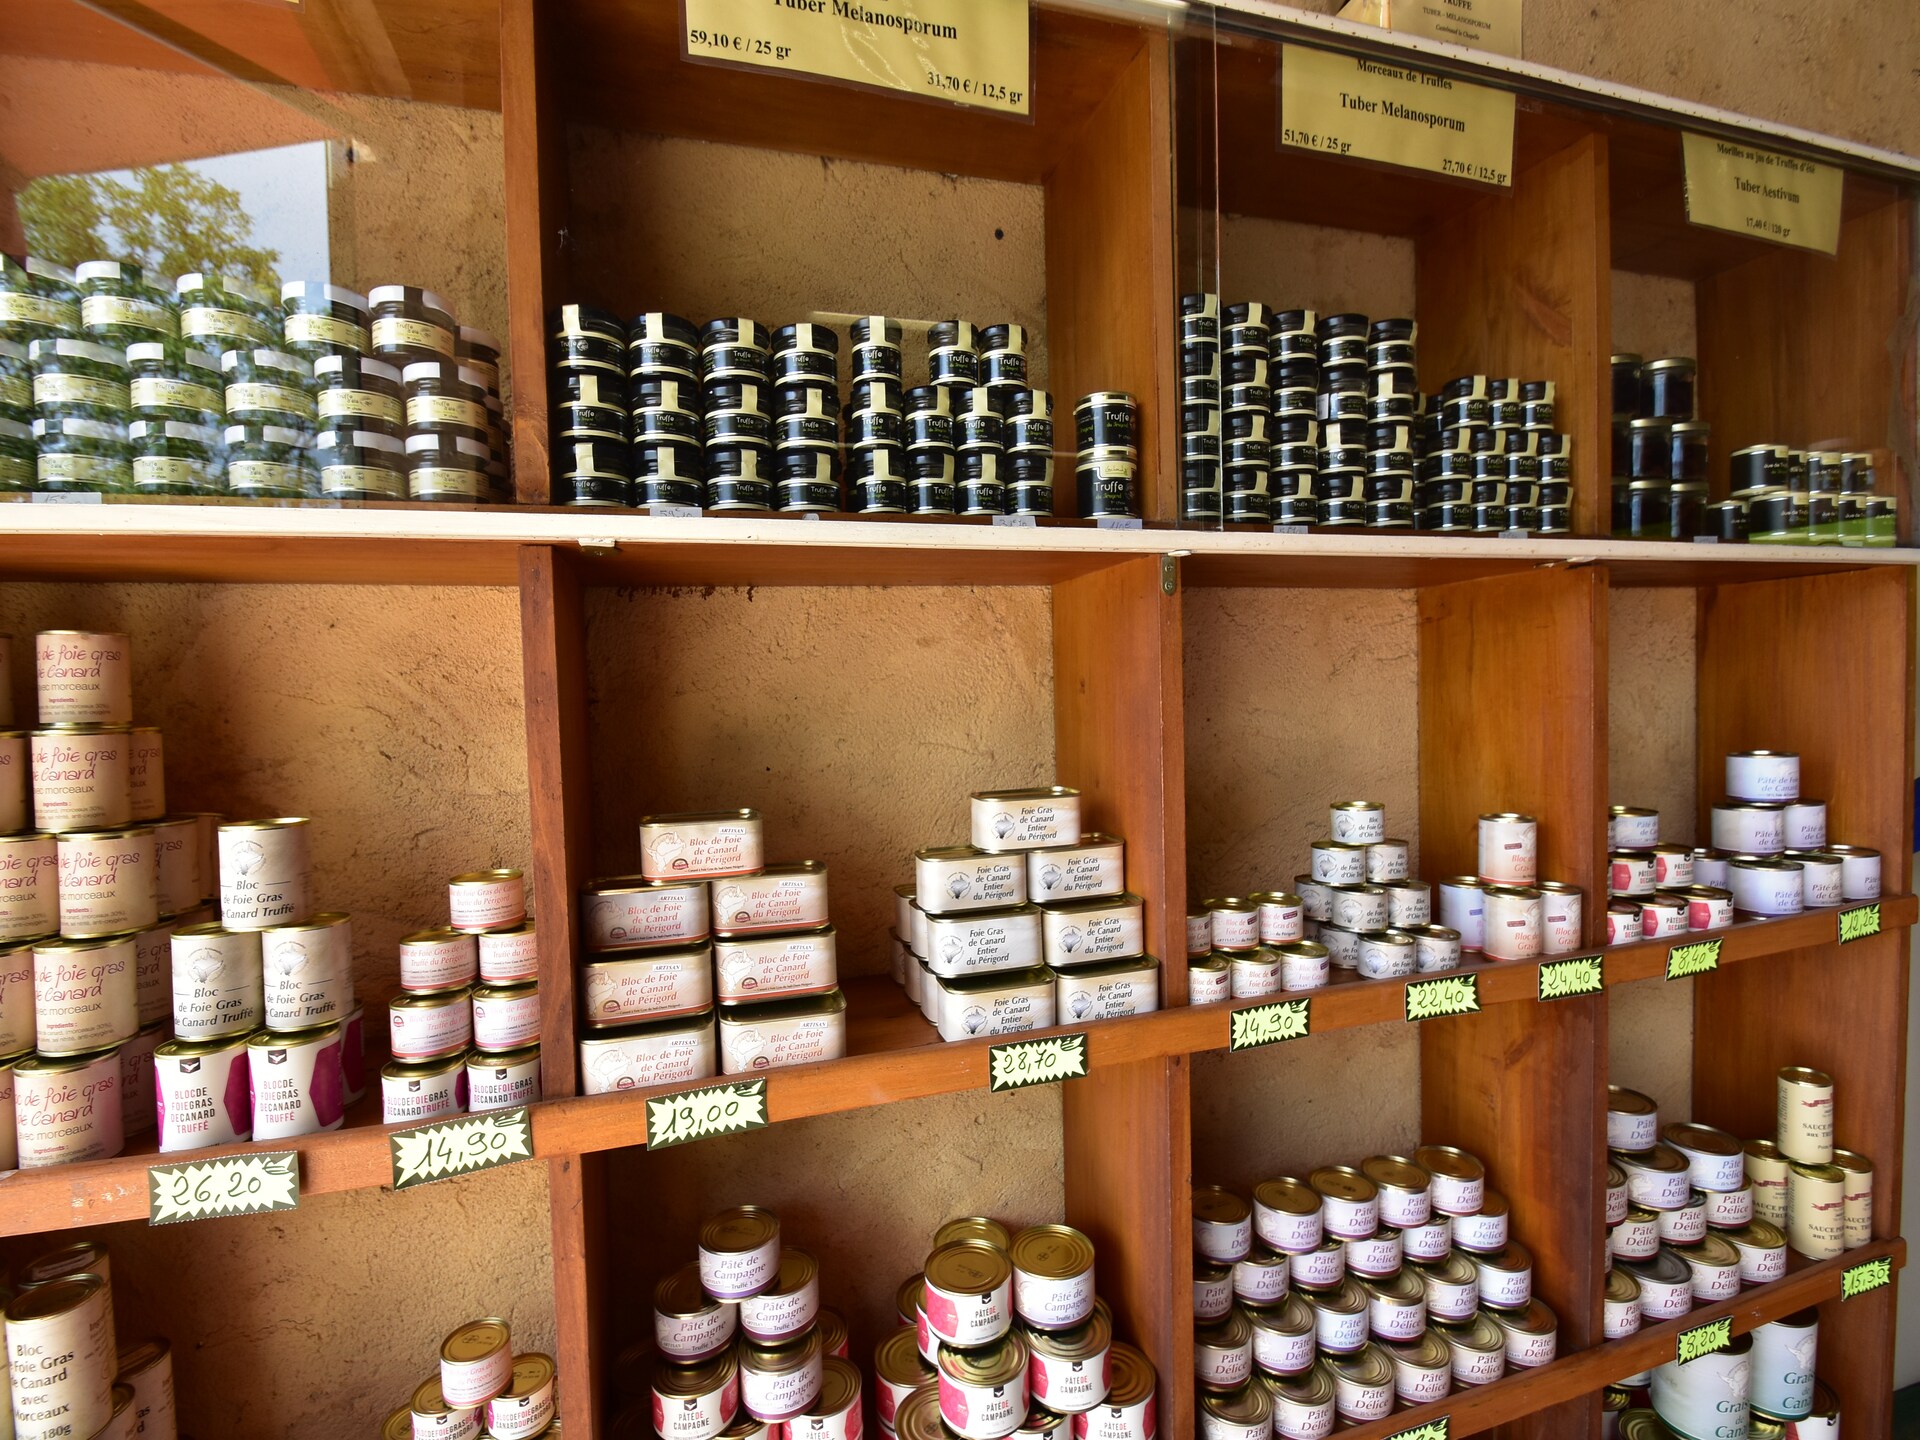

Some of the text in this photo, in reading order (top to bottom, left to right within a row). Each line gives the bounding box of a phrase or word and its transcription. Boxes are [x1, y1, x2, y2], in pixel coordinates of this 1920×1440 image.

[832, 0, 958, 40] Melanosporum
[690, 30, 729, 49] 59,10
[732, 37, 742, 51] €
[755, 40, 772, 56] 25
[776, 46, 791, 59] gr
[1357, 59, 1453, 90] Morceaux de Truffes
[927, 71, 960, 92] 31,70
[962, 79, 971, 93] €
[982, 83, 1006, 101] 12,5
[1009, 90, 1023, 104] gr
[1339, 93, 1465, 132] Tuber Melanosporum
[1284, 129, 1309, 146] 51,70
[1312, 135, 1317, 146] €
[1327, 137, 1338, 150] 25
[1341, 140, 1351, 154] gr
[1717, 143, 1744, 158] Morilles
[1442, 158, 1465, 175] 27,70
[1466, 165, 1472, 176] €
[1479, 166, 1495, 181] 12,5
[1497, 172, 1507, 184] gr
[1735, 176, 1799, 203] Tuber Aestivum
[861, 350, 882, 360] Truffe
[949, 354, 969, 364] Truffe
[1000, 357, 1020, 367] Truffe
[1105, 412, 1129, 422] Truffe
[964, 420, 986, 430] Truffe
[1094, 481, 1123, 493] Truffe
[58, 644, 86, 665] foie
[91, 650, 121, 665] gras
[47, 662, 100, 678] Canard
[52, 682, 100, 691] morceaux
[1021, 806, 1053, 815] Foie Gras
[689, 835, 742, 847] Bloc de Foie
[694, 845, 738, 856] de Canard
[691, 854, 741, 867] du Périgord
[236, 880, 259, 890] Bloc
[970, 928, 1004, 937] Foie Gras
[1515, 933, 1531, 941] Bloc
[968, 936, 1006, 946] de Canard
[977, 947, 998, 955] Entier
[967, 953, 1009, 965] du Périgord
[1678, 949, 1706, 969] 8,40
[1550, 967, 1591, 990] 24,40
[194, 987, 219, 998] Bloc
[1417, 986, 1464, 1008] 22,40
[179, 997, 242, 1012] de Foie Gras
[182, 1007, 254, 1027] Canard Truffé
[1240, 1013, 1293, 1039] 14,90
[1003, 1051, 1056, 1074] 28,70
[25, 1076, 114, 1111] de foie gras
[31, 1098, 94, 1127] Canard
[37, 1121, 94, 1140] morceaux
[177, 1120, 209, 1134] TRUFFÉ
[414, 1132, 506, 1170] 14,90
[172, 1171, 262, 1206] 26,20
[1723, 1194, 1746, 1205] Pâté
[1716, 1202, 1749, 1215] Délice
[1424, 1229, 1446, 1239] Pâté
[1632, 1225, 1654, 1236] Pâté
[1419, 1237, 1448, 1249] Délice
[1626, 1234, 1657, 1247] Délice
[720, 1255, 759, 1270] Pâté de
[714, 1262, 766, 1281] Campagne
[1263, 1268, 1283, 1279] Pâté
[1256, 1276, 1287, 1289] Délice
[1396, 1308, 1418, 1319] Pâté
[1390, 1317, 1422, 1329] Délice
[1687, 1331, 1716, 1354] 8,20
[17, 1344, 43, 1357] Bloc
[14, 1351, 75, 1373] Foie Gras
[20, 1367, 68, 1390] Canard
[1060, 1383, 1093, 1394] CAMPAGNE
[1362, 1388, 1385, 1399] Pâté
[21, 1393, 49, 1405] avec
[1355, 1397, 1390, 1410] Délice
